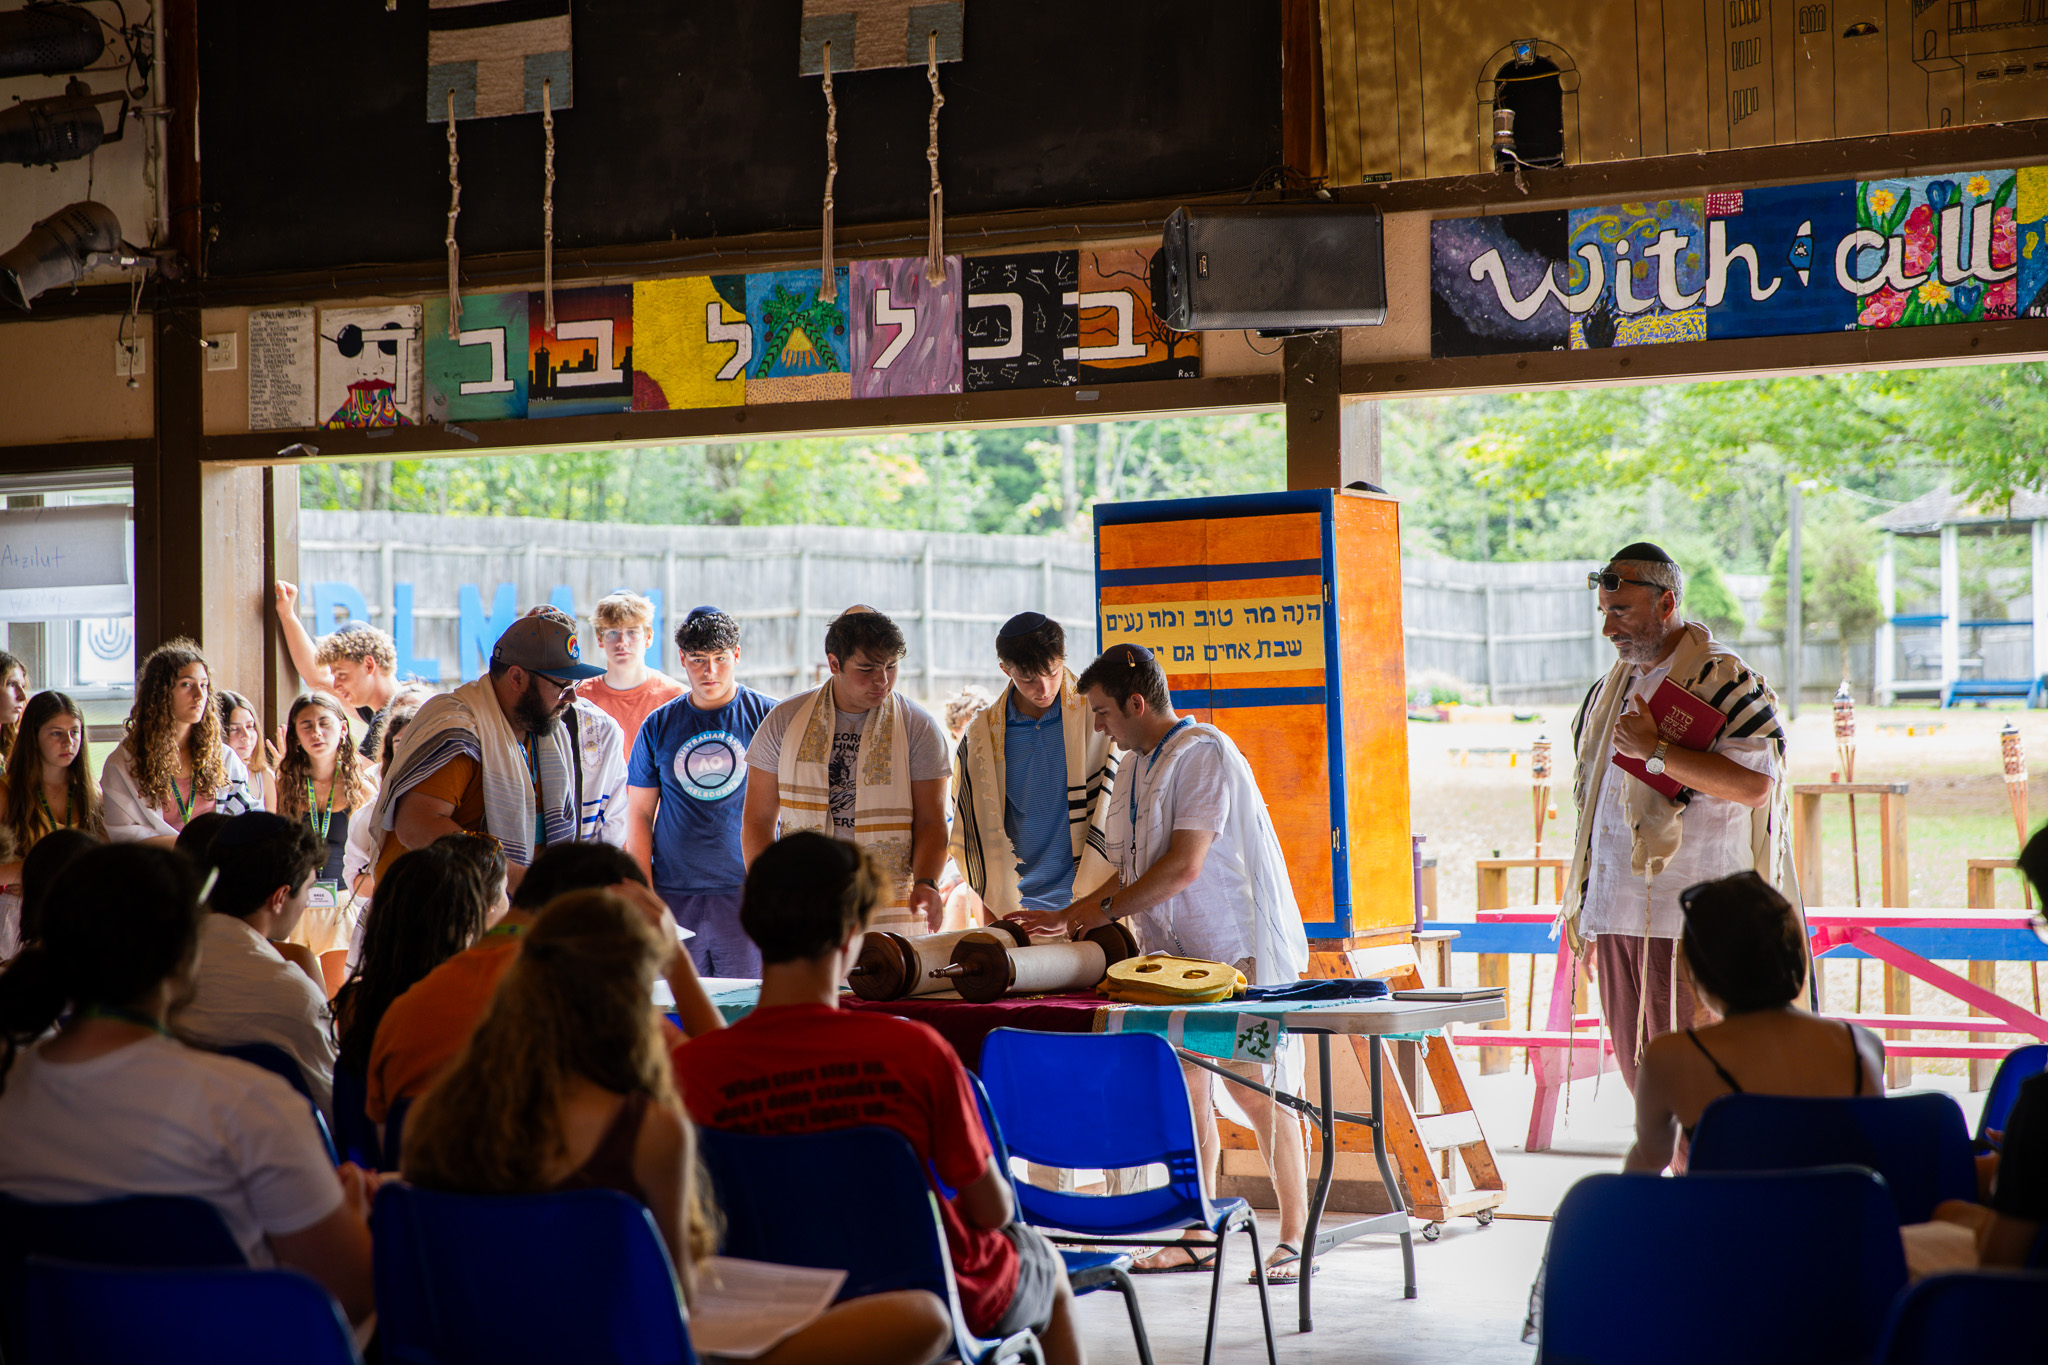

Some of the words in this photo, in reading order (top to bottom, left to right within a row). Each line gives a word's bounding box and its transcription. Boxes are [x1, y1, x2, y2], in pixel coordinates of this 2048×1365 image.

[1835, 200, 2016, 298] all
[949, 383, 961, 393] LK
[1, 543, 66, 569] Atzilut
[1106, 612, 1144, 632] נעים
[1148, 610, 1185, 629] ומה
[1194, 608, 1233, 627] טוב
[1243, 606, 1276, 624] מה
[1282, 603, 1321, 625] הנה
[1172, 645, 1195, 662] גם
[1203, 643, 1252, 662] אחים
[1253, 639, 1302, 661] שבת
[1660, 722, 1682, 740] Siddur
[677, 733, 725, 764] AUSTRALIAN
[726, 735, 744, 757] OPEN
[698, 756, 723, 772] AO
[686, 780, 739, 798] MELBOURNE
